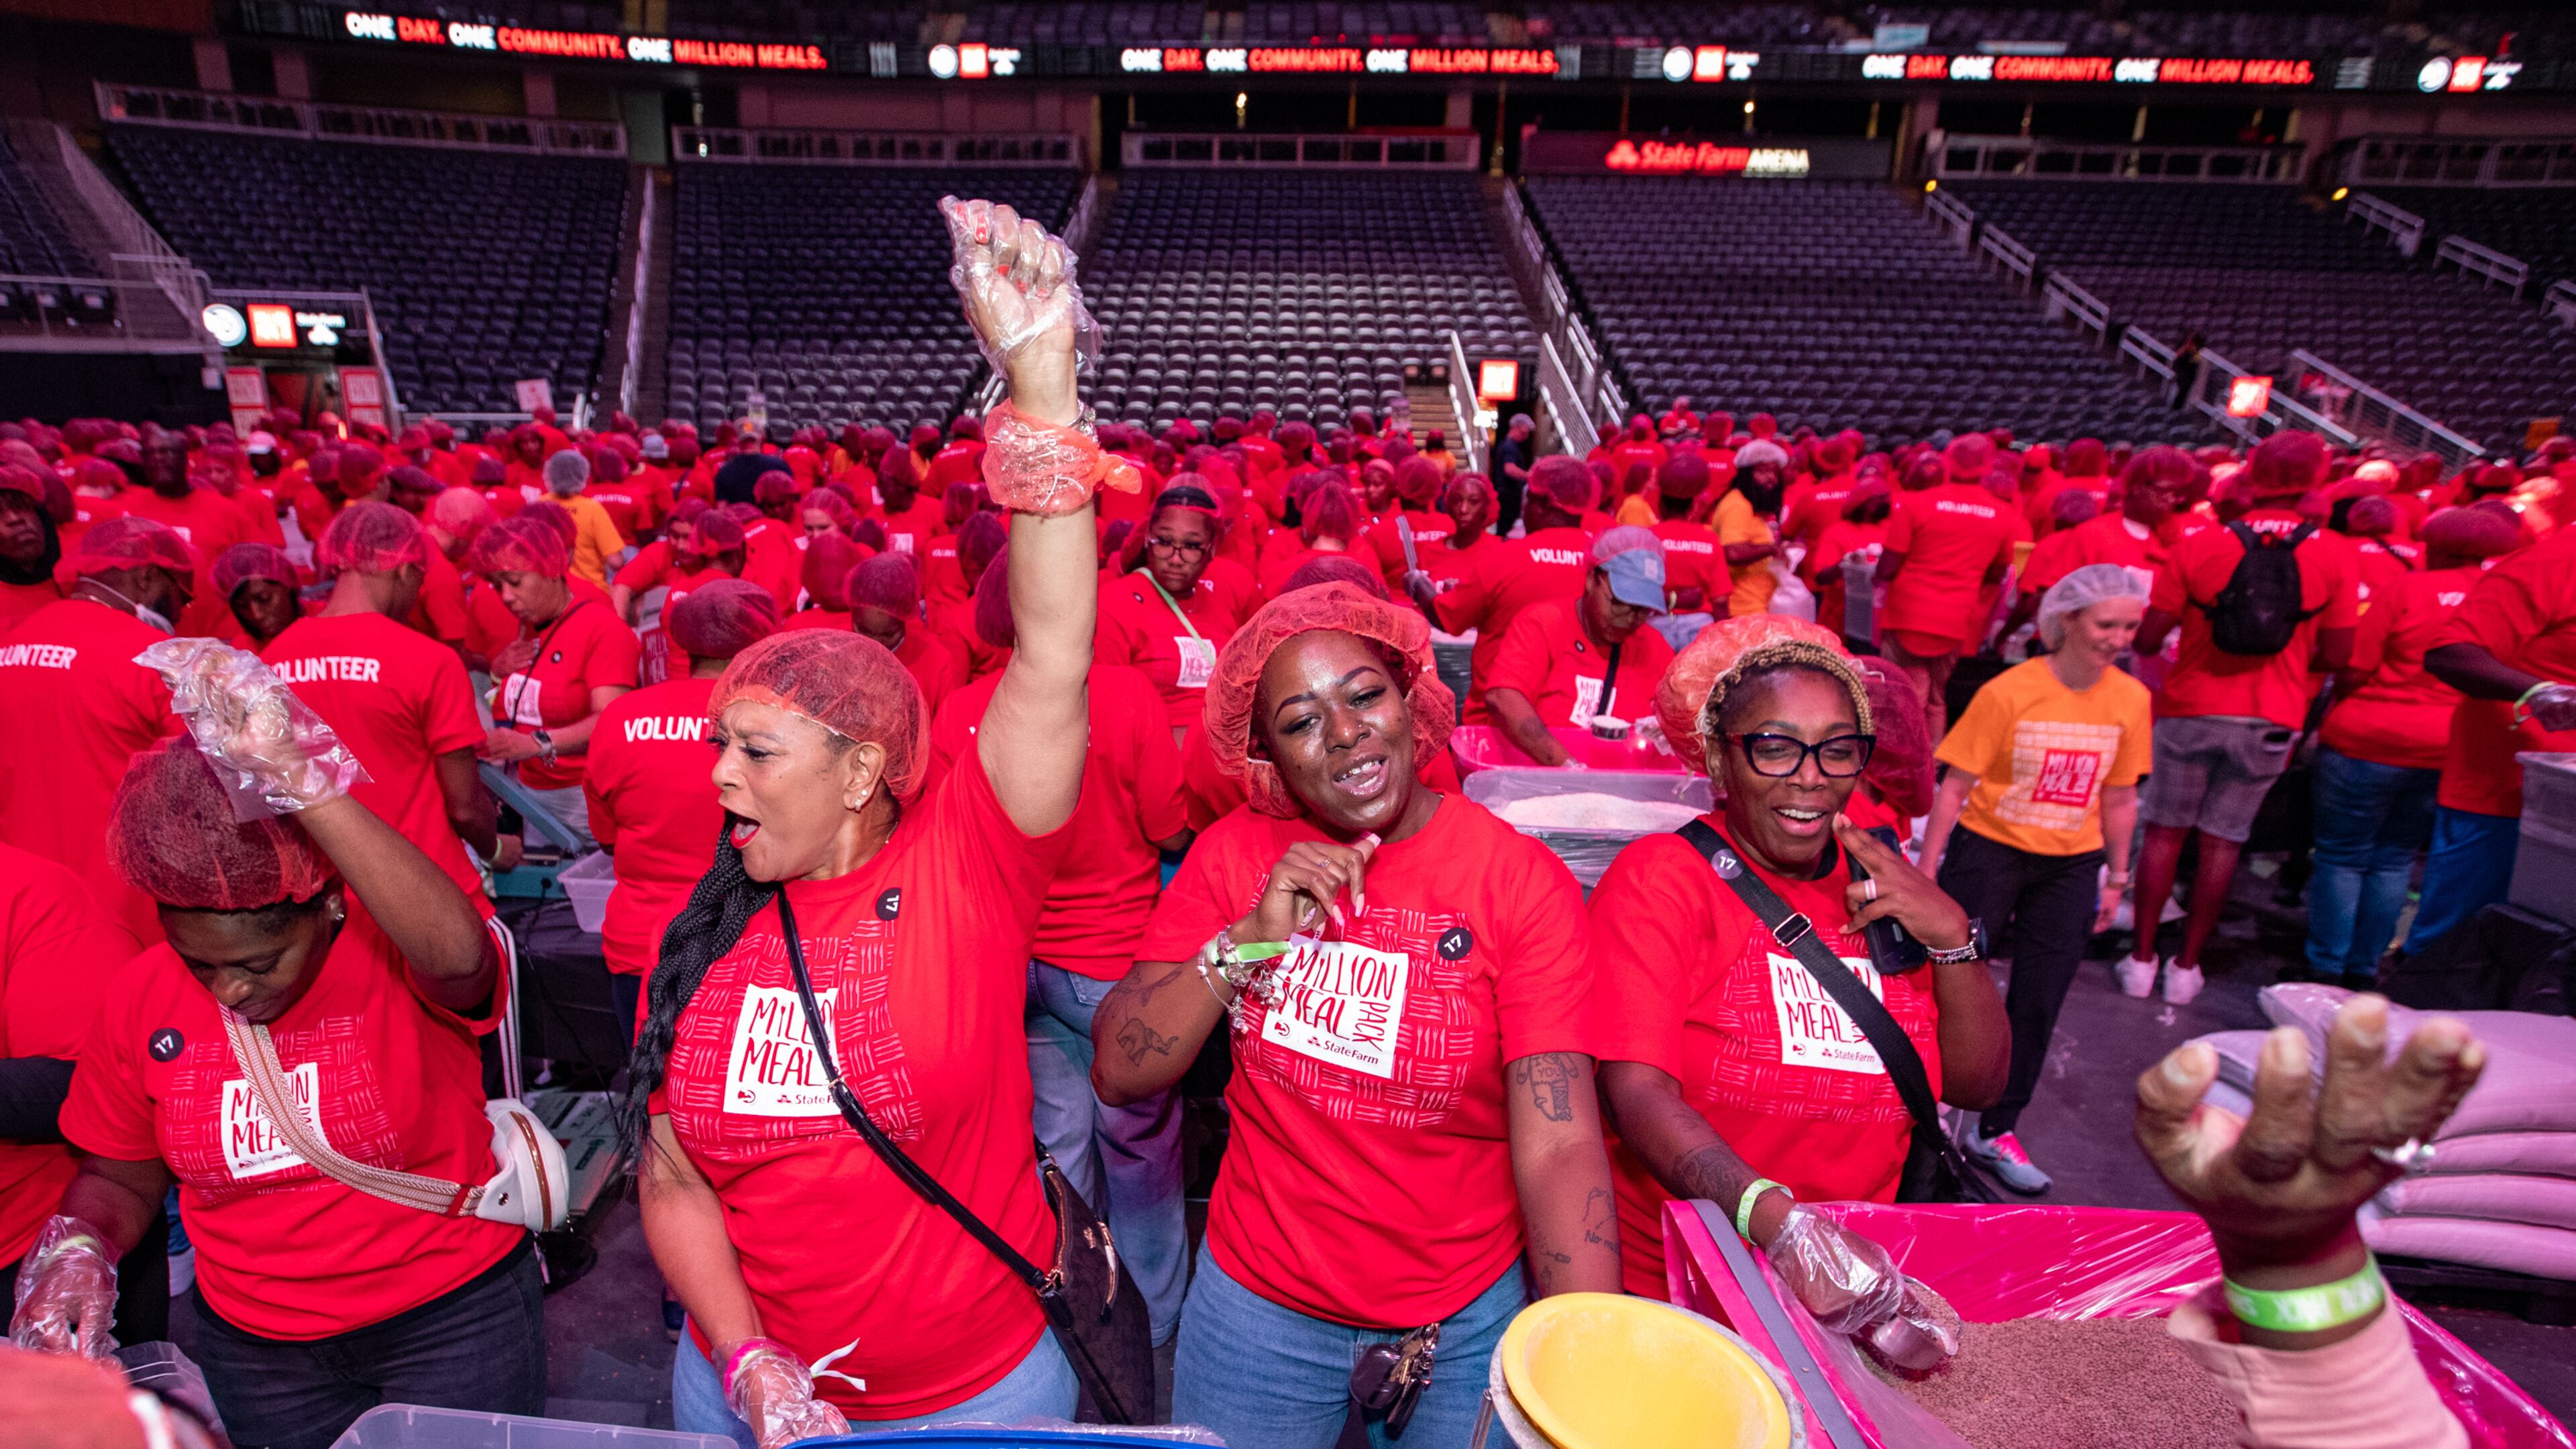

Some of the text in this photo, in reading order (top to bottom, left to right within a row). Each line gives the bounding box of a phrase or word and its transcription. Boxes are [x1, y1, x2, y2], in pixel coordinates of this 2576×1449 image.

[345, 12, 827, 69] ONE DAY. ONE COMMUNITY. ONE MILLION MEALS.
[1121, 48, 1560, 73] ONE DAY. ONE COMMUNITY. ONE MILLION MEALS.
[1862, 54, 1907, 79] ONE
[1949, 56, 1994, 80] ONE
[2114, 58, 2160, 82] ONE
[2157, 58, 2242, 83] MILLION
[1640, 140, 1810, 172] State Farm ARENA
[0, 644, 78, 670] LUNTEER
[272, 655, 380, 684] OLUNTEER
[624, 716, 709, 743] VOLUN
[1719, 855, 1737, 870] 17
[885, 895, 900, 912] 17
[1444, 933, 1463, 953] 17
[1287, 946, 1397, 1000] MILLION
[1277, 975, 1350, 1040] MEAL
[1785, 1000, 1852, 1043] MEAL
[1352, 1000, 1391, 1052] PACK
[155, 1034, 174, 1055] 17
[739, 1036, 828, 1087] MEAL
[232, 1116, 286, 1159] MEA
